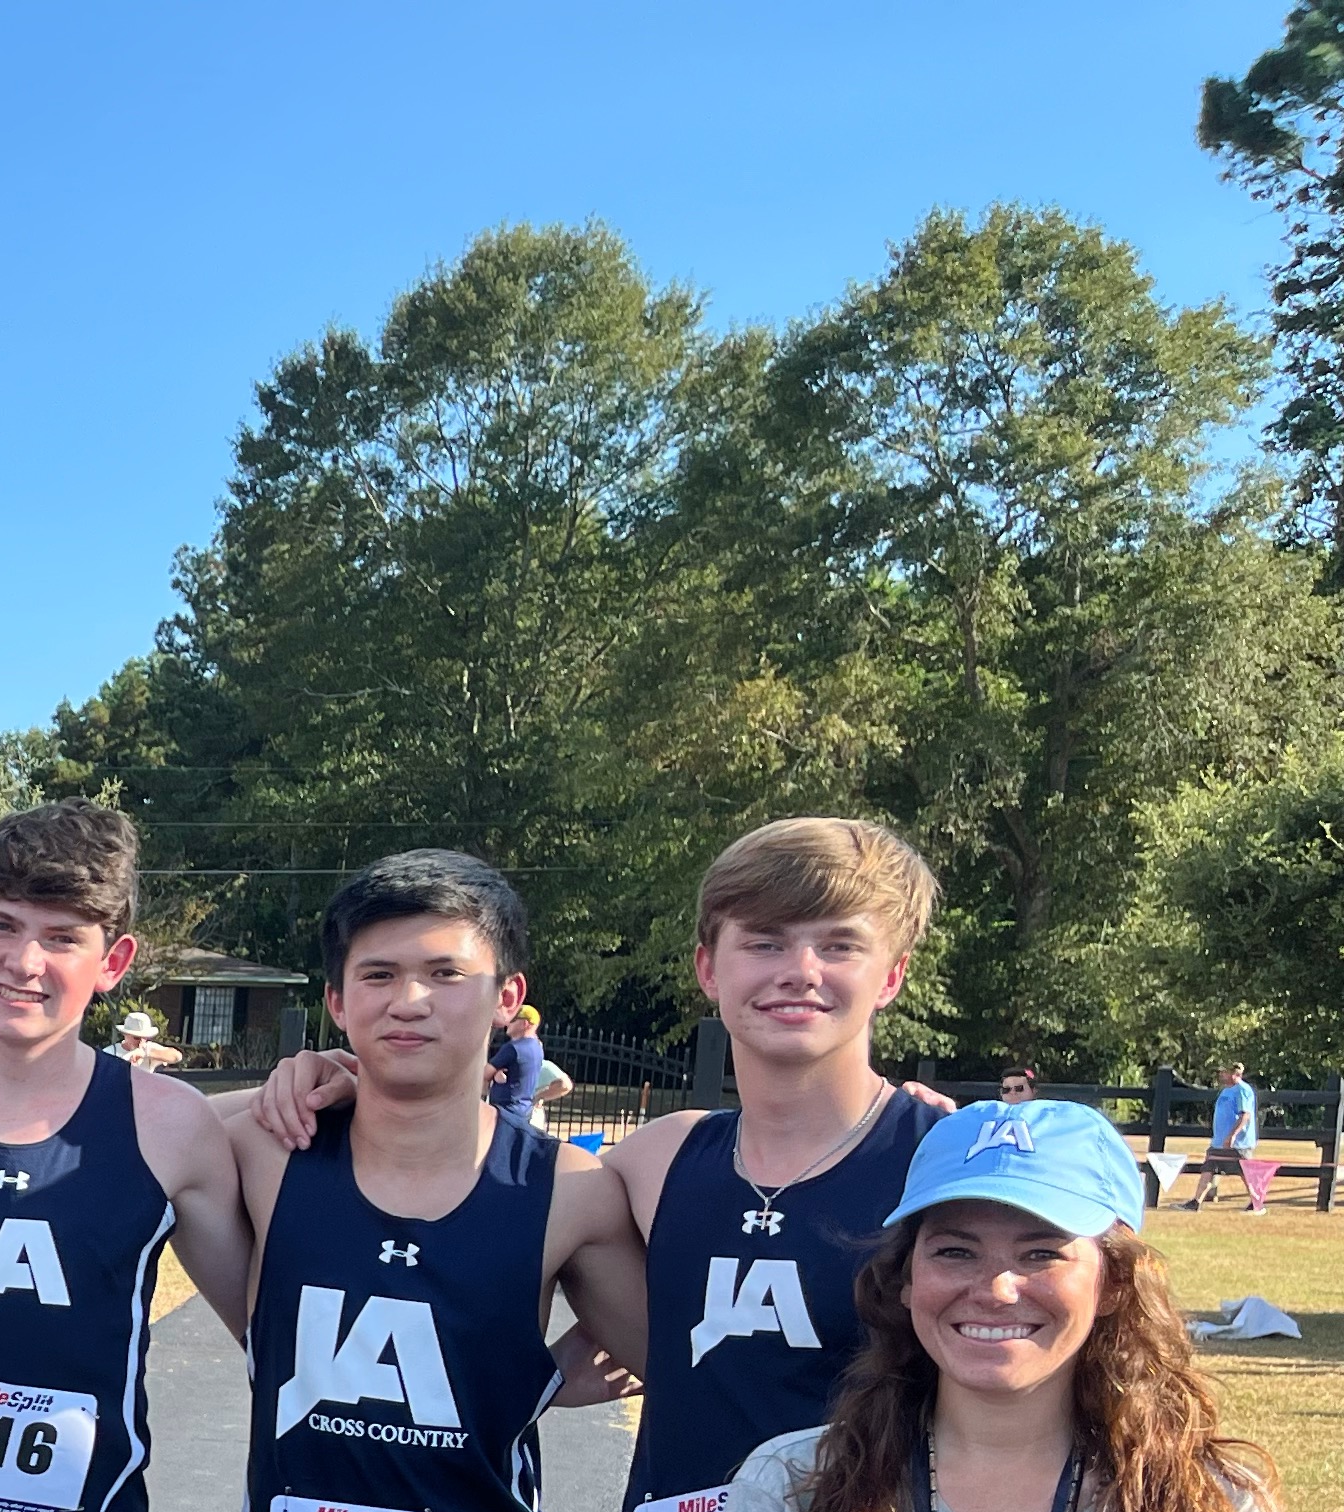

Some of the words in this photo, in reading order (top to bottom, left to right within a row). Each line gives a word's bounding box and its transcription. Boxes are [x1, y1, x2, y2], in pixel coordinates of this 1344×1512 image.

[964, 1119, 1035, 1164] JA
[691, 1256, 822, 1367] JA
[276, 1285, 462, 1439] JA
[308, 1413, 365, 1438] CROSS
[368, 1422, 469, 1449] COUNTRY
